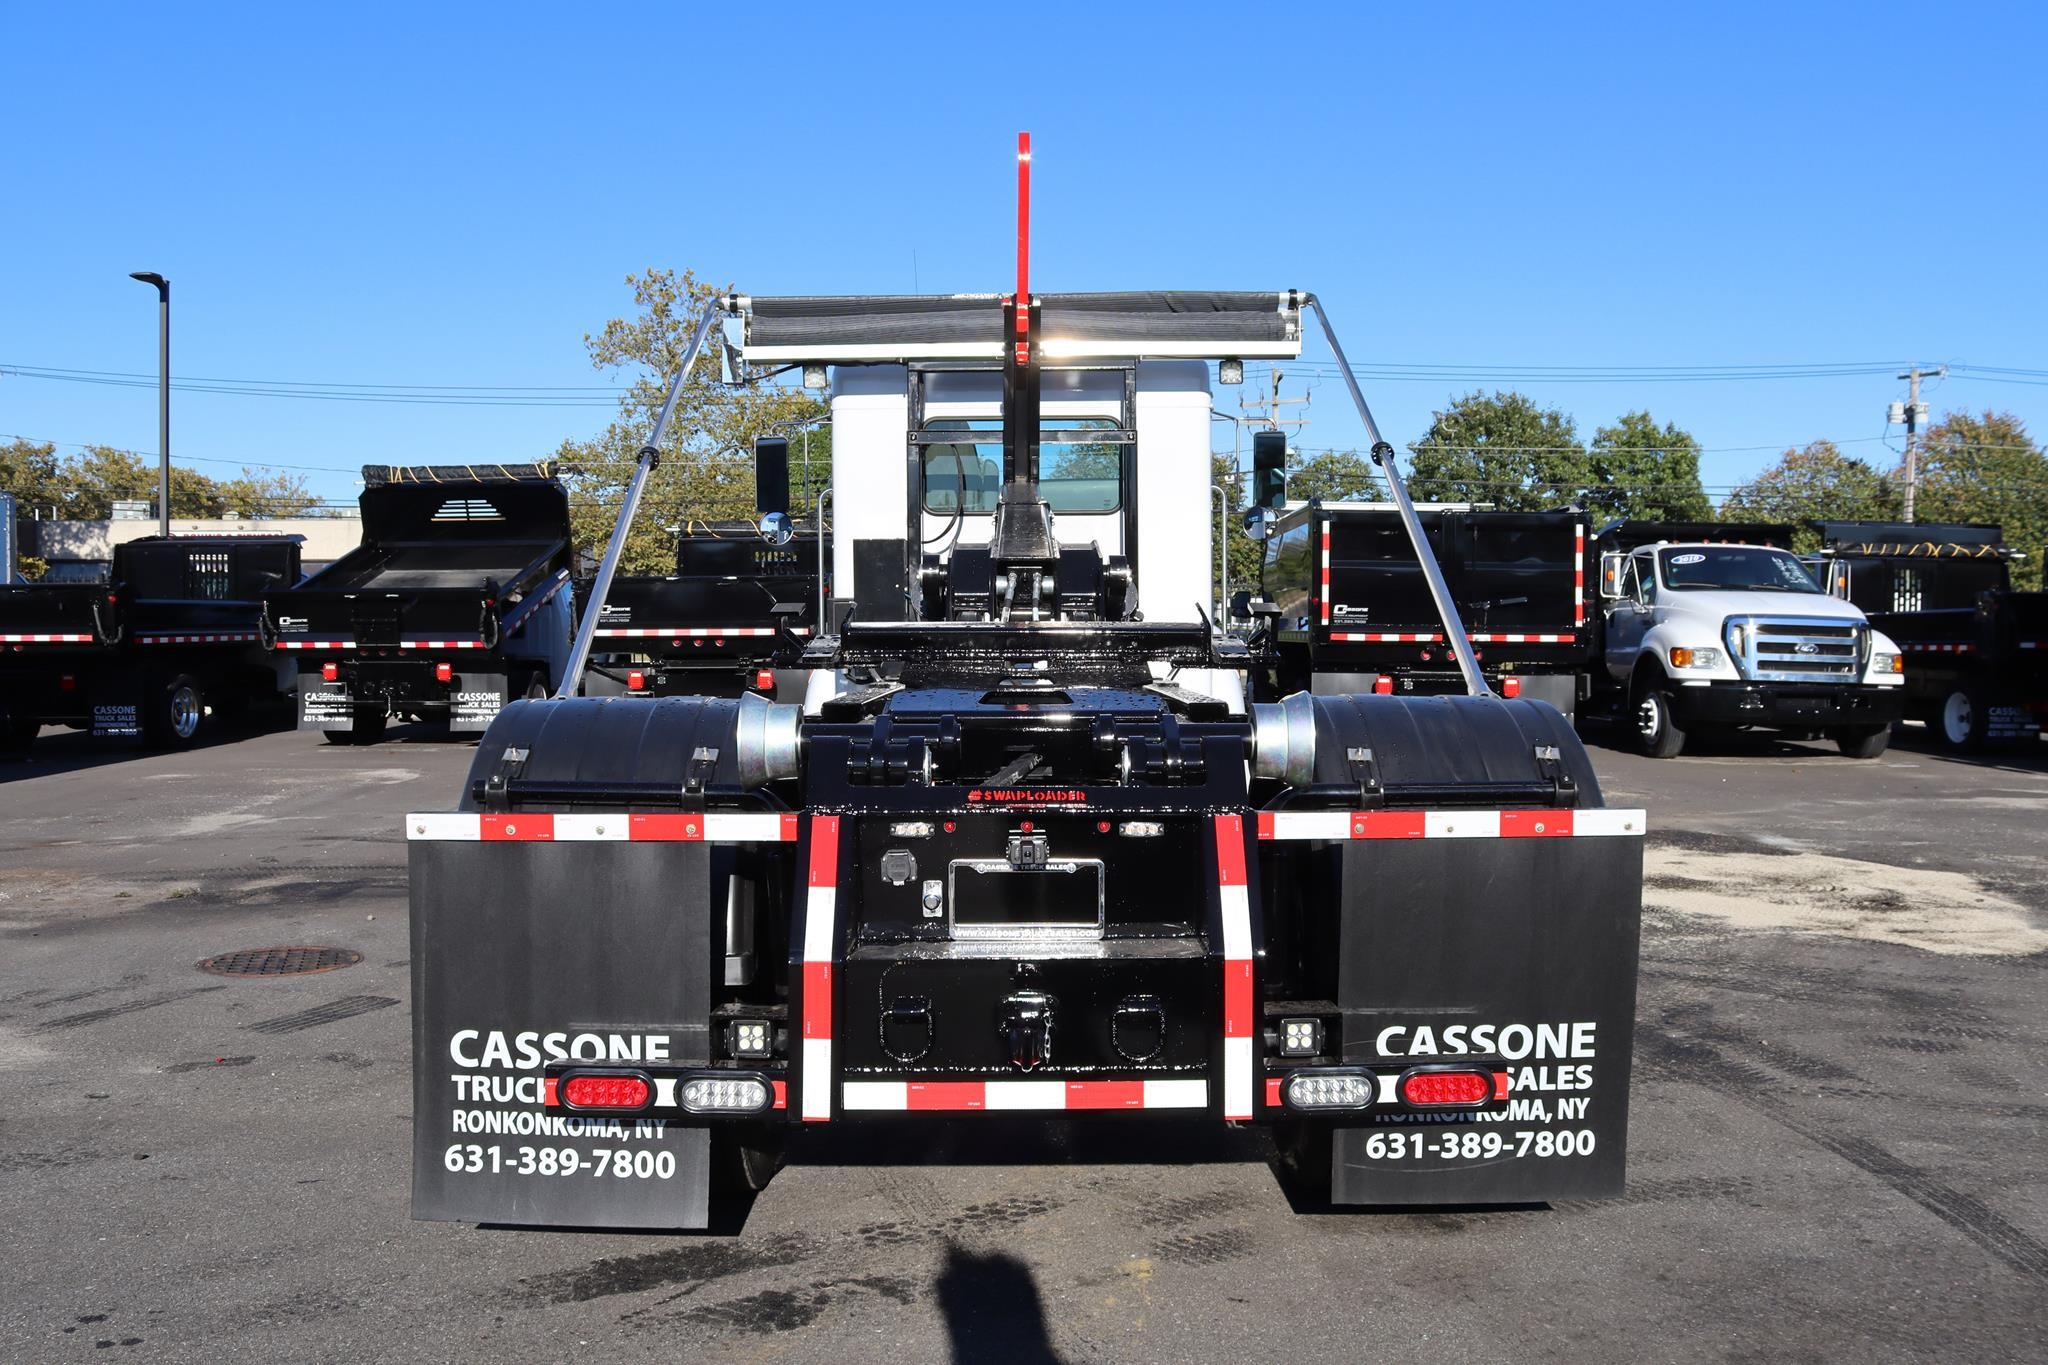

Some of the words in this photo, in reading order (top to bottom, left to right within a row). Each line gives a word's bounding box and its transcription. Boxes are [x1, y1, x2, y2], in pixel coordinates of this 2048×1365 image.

[94, 705, 137, 715] CASSONE
[457, 692, 501, 701] CASSONE
[984, 790, 1086, 801] SWAPLOADER
[450, 1029, 670, 1069] CASSONE
[1376, 1022, 1597, 1060] CASSONE
[1557, 1097, 1591, 1120] NY
[452, 1109, 631, 1142] RONKONKOMA,
[635, 1118, 668, 1139] NY
[1365, 1129, 1596, 1160] 631-389-7800
[444, 1144, 676, 1180] 631-389-7800
